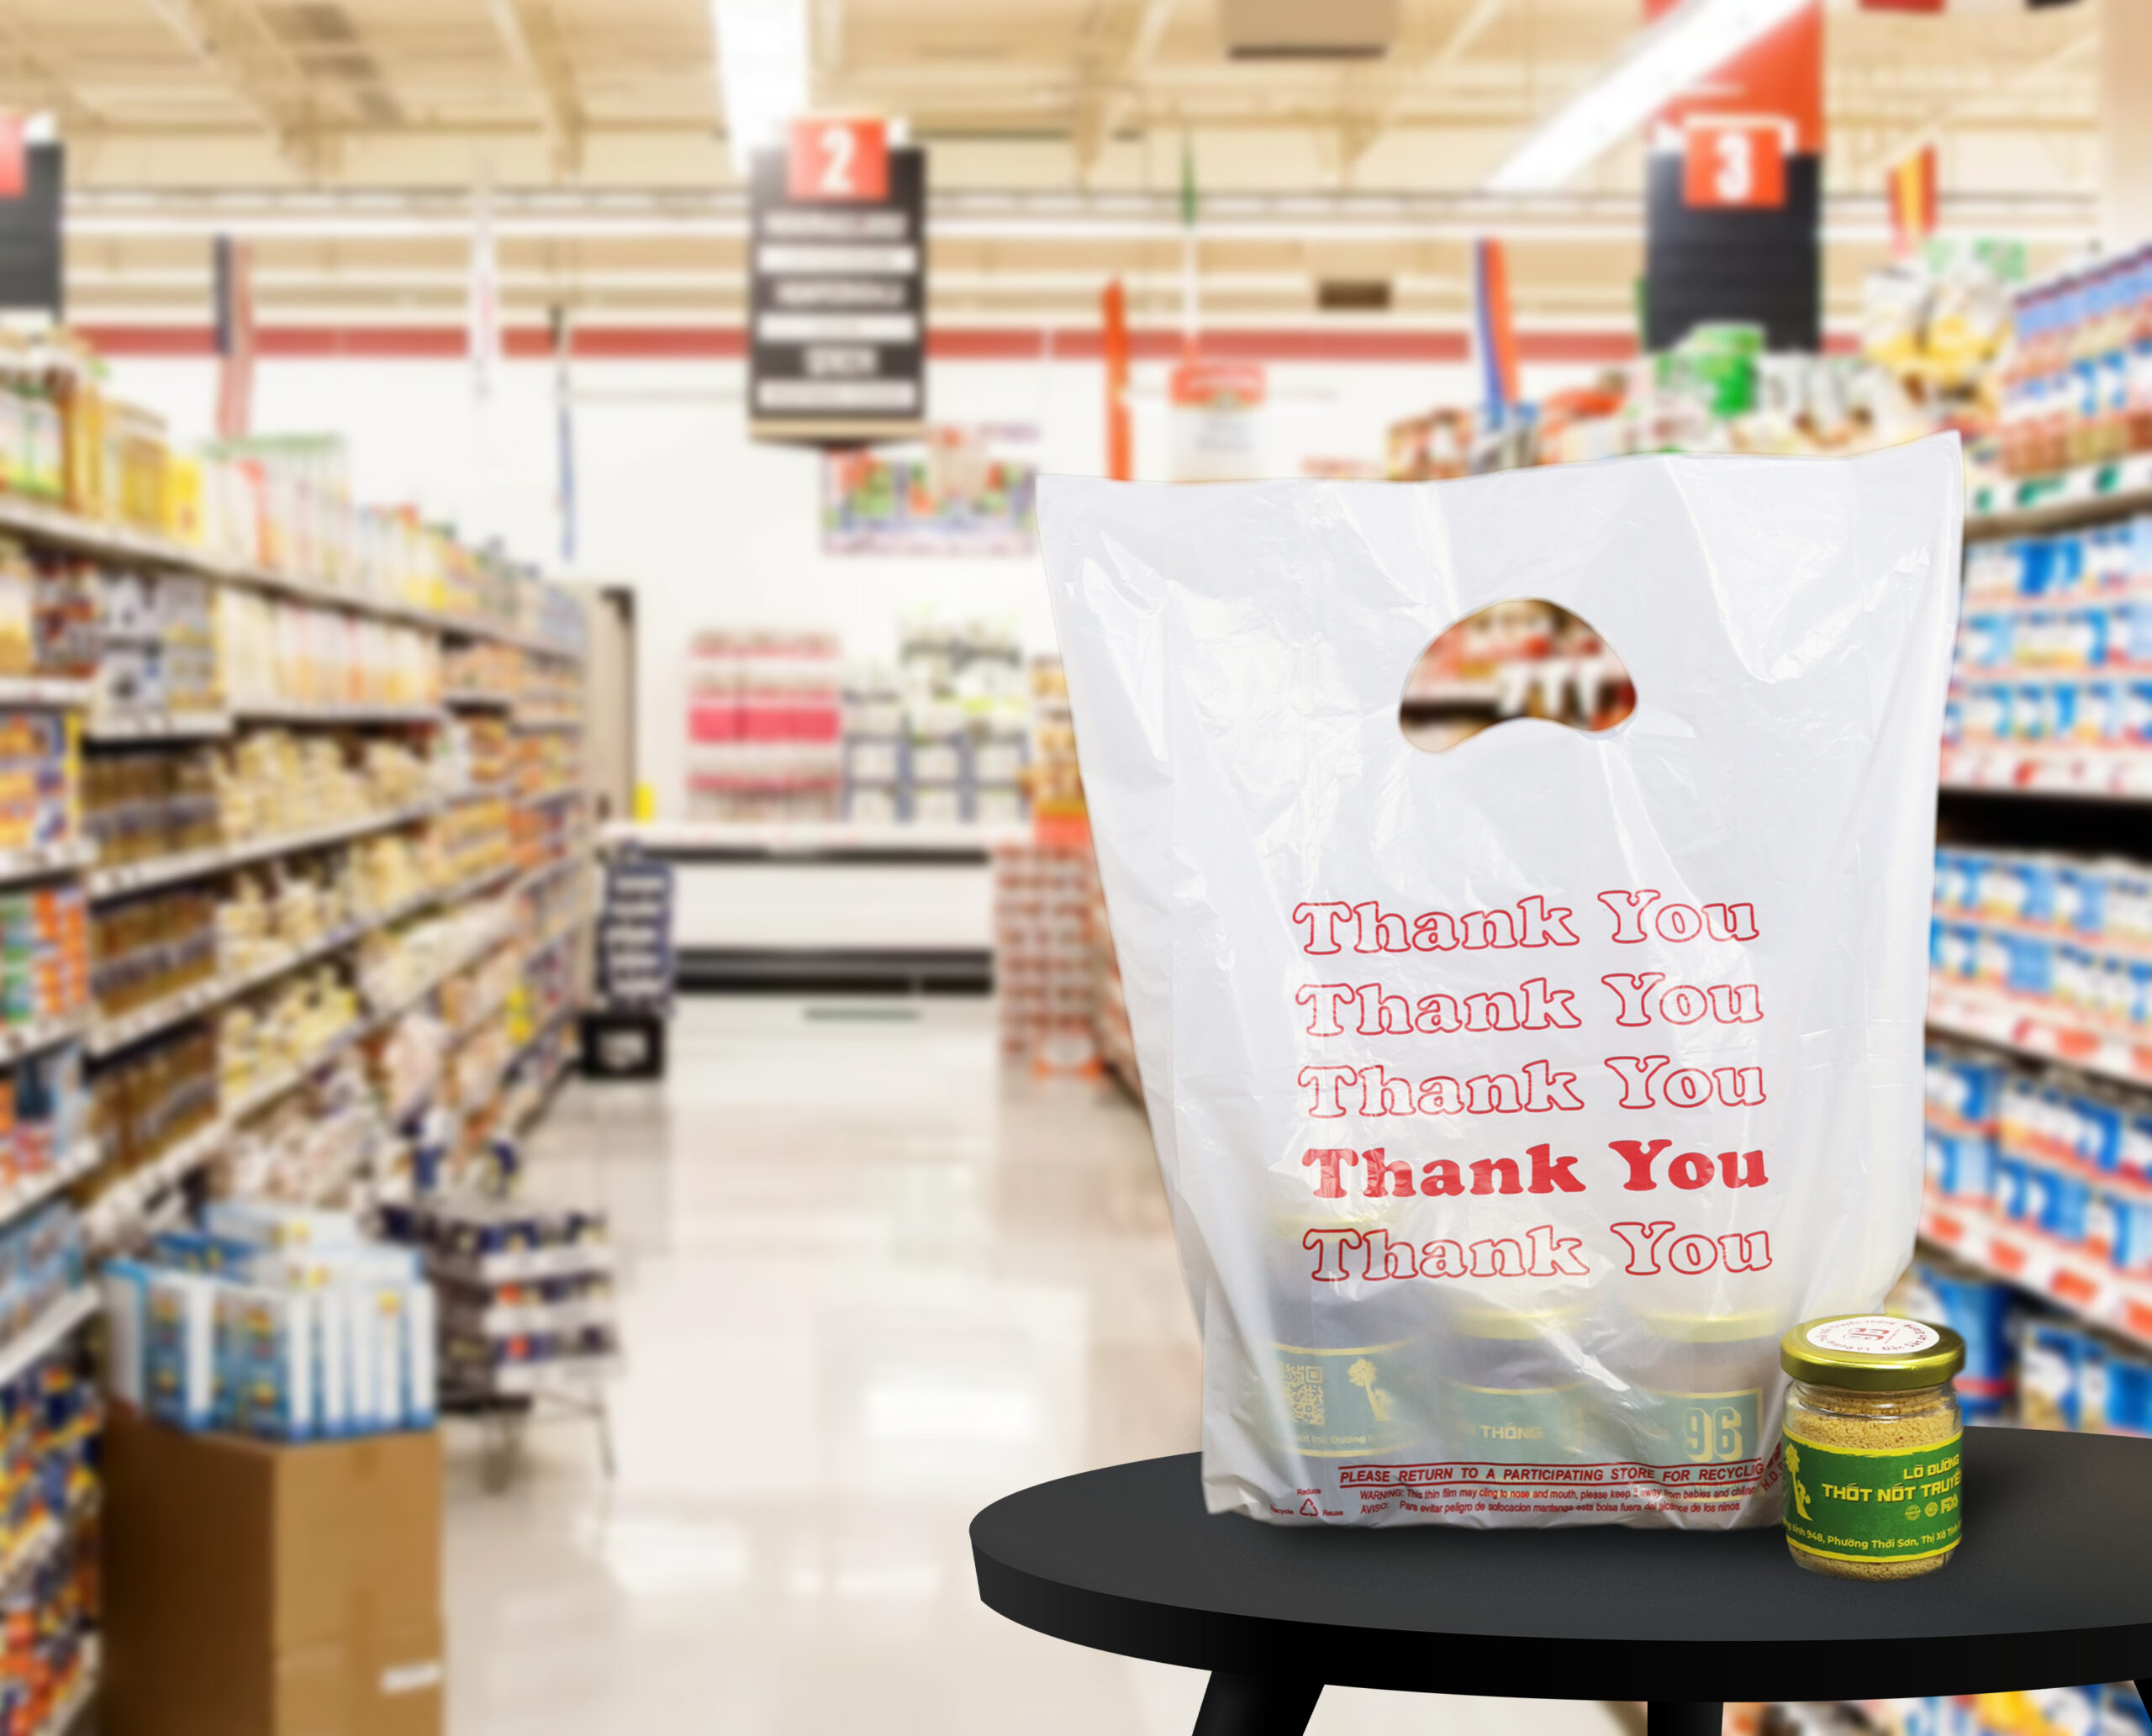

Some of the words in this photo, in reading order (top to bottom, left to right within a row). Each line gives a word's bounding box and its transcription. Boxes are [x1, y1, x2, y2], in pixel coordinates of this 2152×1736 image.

[819, 125, 857, 195] 2
[1715, 133, 1750, 203] 3
[1292, 894, 1580, 955] Thank
[1597, 889, 1759, 944] You
[1295, 977, 1582, 1037] Thank
[1601, 972, 1764, 1027] You
[1298, 1059, 1585, 1119] Thank
[1604, 1055, 1767, 1110] You
[1301, 1143, 1586, 1199] Thank
[1608, 1139, 1769, 1191] You
[1302, 1225, 1590, 1282] Thank
[1610, 1221, 1773, 1276] You
[1683, 1406, 1743, 1463] 96
[1340, 1470, 1390, 1483] PLEASE
[1398, 1467, 1453, 1482] RETURN
[1461, 1467, 1480, 1479] TO
[1485, 1468, 1495, 1480] A
[1503, 1468, 1604, 1481] PARTICIPATING
[1611, 1467, 1655, 1480] STORE
[1662, 1470, 1690, 1483] FOR
[1360, 1489, 1405, 1501] WARNING:
[1407, 1489, 1423, 1500] This
[1425, 1489, 1440, 1500] thin
[1443, 1488, 1457, 1499] film
[1459, 1489, 1478, 1500] may
[1479, 1487, 1498, 1500] cling
[1500, 1489, 1508, 1499] to
[1510, 1491, 1530, 1499] nose
[1532, 1489, 1549, 1499] and
[1550, 1489, 1579, 1501] mouth,
[1580, 1491, 1609, 1501] please
[1610, 1489, 1631, 1501] keep
[1684, 1489, 1712, 1499] babies
[1713, 1488, 1729, 1499] and
[1360, 1502, 1390, 1514] AVISO:
[1400, 1501, 1418, 1512] Para
[1420, 1502, 1443, 1512] evitar
[1444, 1501, 1473, 1514] peligro
[1474, 1501, 1486, 1511] de
[1488, 1501, 1532, 1512] sofocacion
[1596, 1502, 1618, 1512] bolsa
[1620, 1502, 1642, 1512] fuera
[1690, 1503, 1701, 1512] de
[1703, 1503, 1716, 1512] los
[1807, 1530, 1826, 1544] 948,
